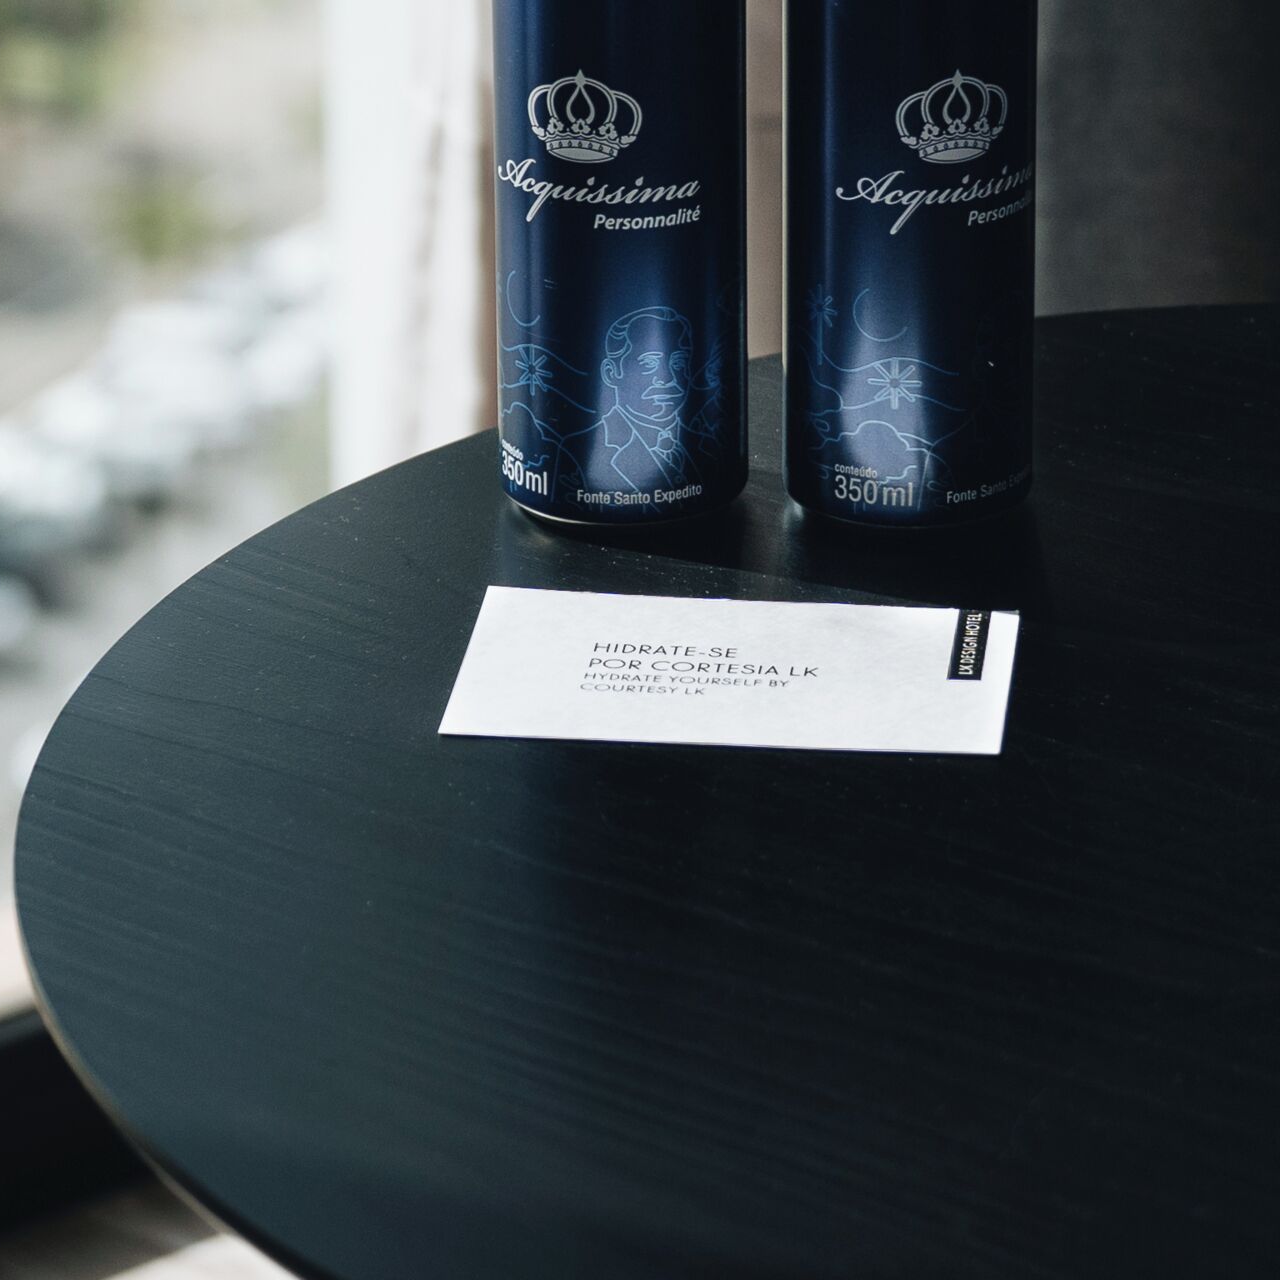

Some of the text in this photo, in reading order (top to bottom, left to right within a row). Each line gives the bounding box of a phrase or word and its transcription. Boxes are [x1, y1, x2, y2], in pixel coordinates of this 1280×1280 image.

[498, 158, 701, 222] Acquissima
[593, 205, 701, 230] Personnalité
[834, 463, 878, 479] conteúdo
[577, 484, 703, 505] Fonte Santo Expedito
[946, 490, 977, 505] Fonte
[964, 613, 983, 636] HOTEL
[593, 642, 738, 659] HIDRATE-SE
[960, 637, 978, 664] DESIGN
[588, 658, 819, 677] POR CORTESIA LK
[579, 682, 706, 696] COURTESY LK
[583, 672, 790, 687] HYDRATE YOURSELF BY
